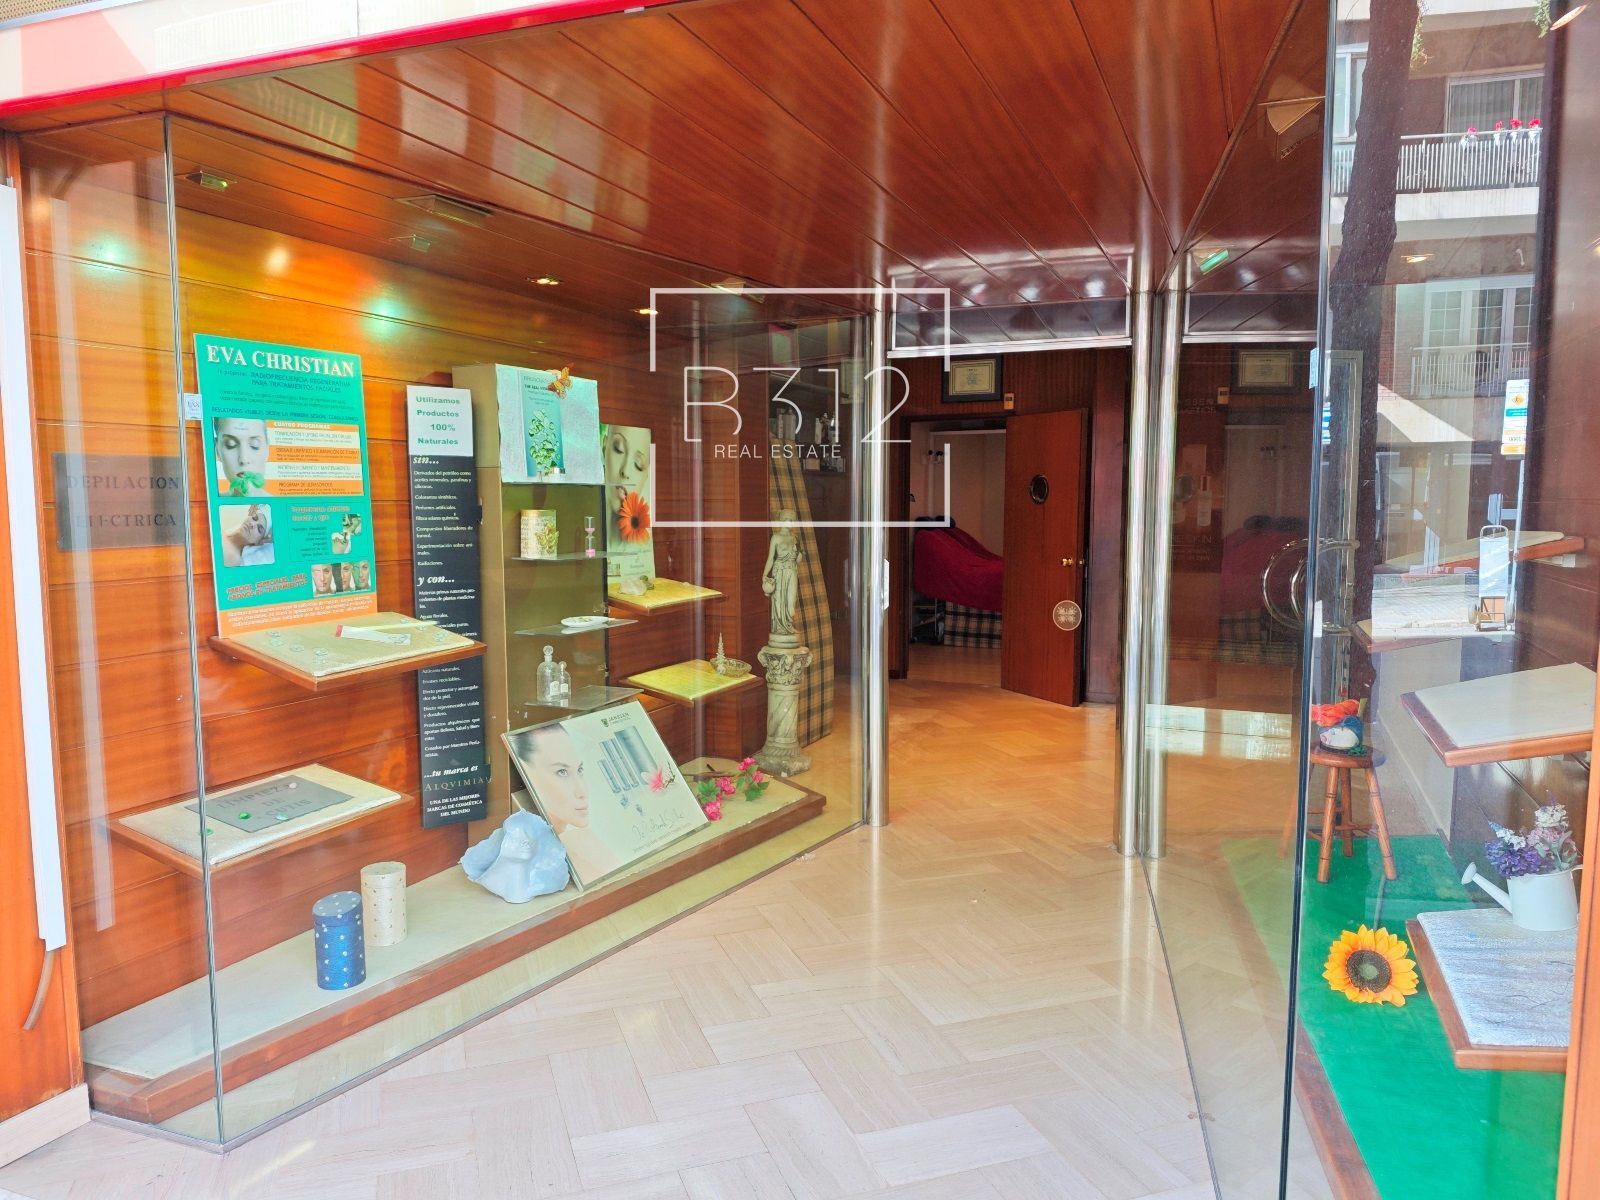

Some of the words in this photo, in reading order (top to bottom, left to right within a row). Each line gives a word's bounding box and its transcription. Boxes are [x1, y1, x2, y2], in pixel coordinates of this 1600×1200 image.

[206, 345, 247, 366] EVA
[252, 351, 354, 378] CHRISTIAN
[416, 396, 460, 404] Utilizamos
[416, 409, 460, 417] Productos
[417, 437, 458, 445] Naturales
[67, 475, 179, 490] DEPILACION
[416, 576, 425, 587] y
[427, 575, 455, 583] con...
[443, 766, 469, 776] marca
[458, 793, 480, 801] MEJORES
[450, 808, 470, 816] MUNDO
